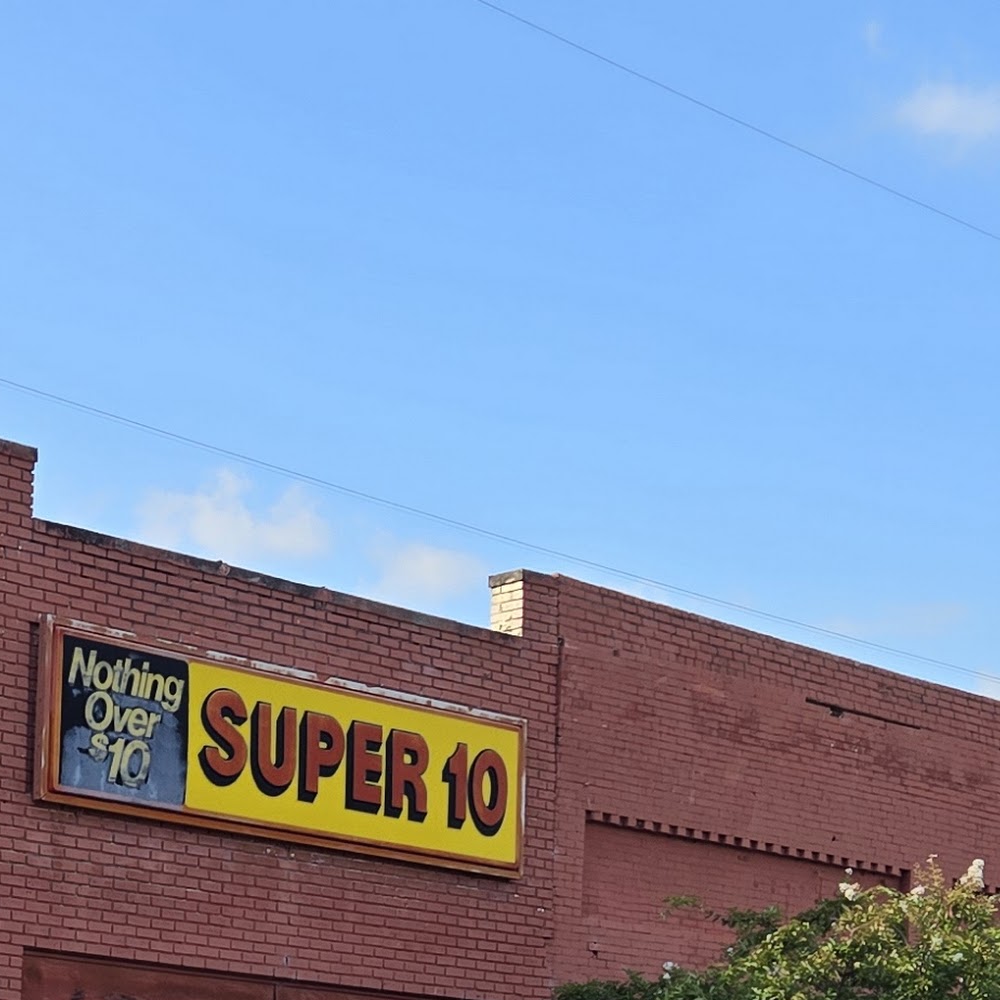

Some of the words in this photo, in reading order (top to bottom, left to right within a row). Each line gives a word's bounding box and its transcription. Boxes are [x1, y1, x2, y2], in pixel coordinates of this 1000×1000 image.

[68, 647, 185, 713] Nothing
[85, 691, 162, 738] Over
[88, 732, 151, 789] $10
[198, 688, 430, 823] SUPER
[442, 742, 509, 837] 10
